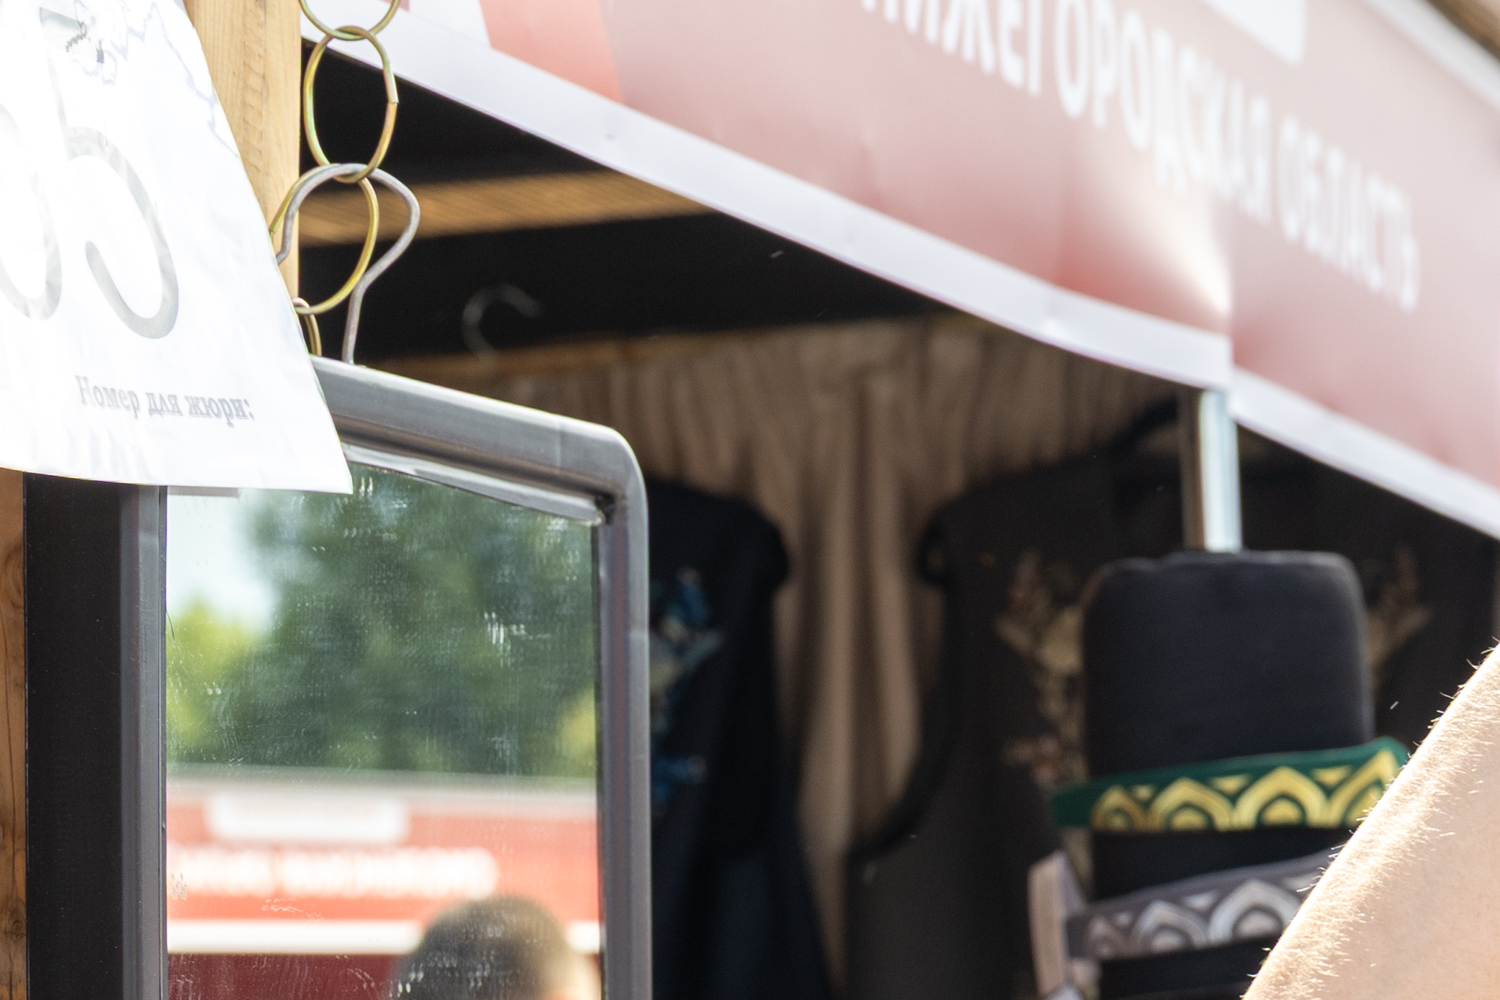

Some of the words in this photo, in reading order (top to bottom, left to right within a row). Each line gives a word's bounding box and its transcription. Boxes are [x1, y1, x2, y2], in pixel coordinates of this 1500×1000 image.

[861, 0, 1271, 225] ЕГОРОДСКАЯ
[75, 375, 140, 419] Номер
[145, 392, 183, 417] для
[184, 395, 255, 428] жюри:
